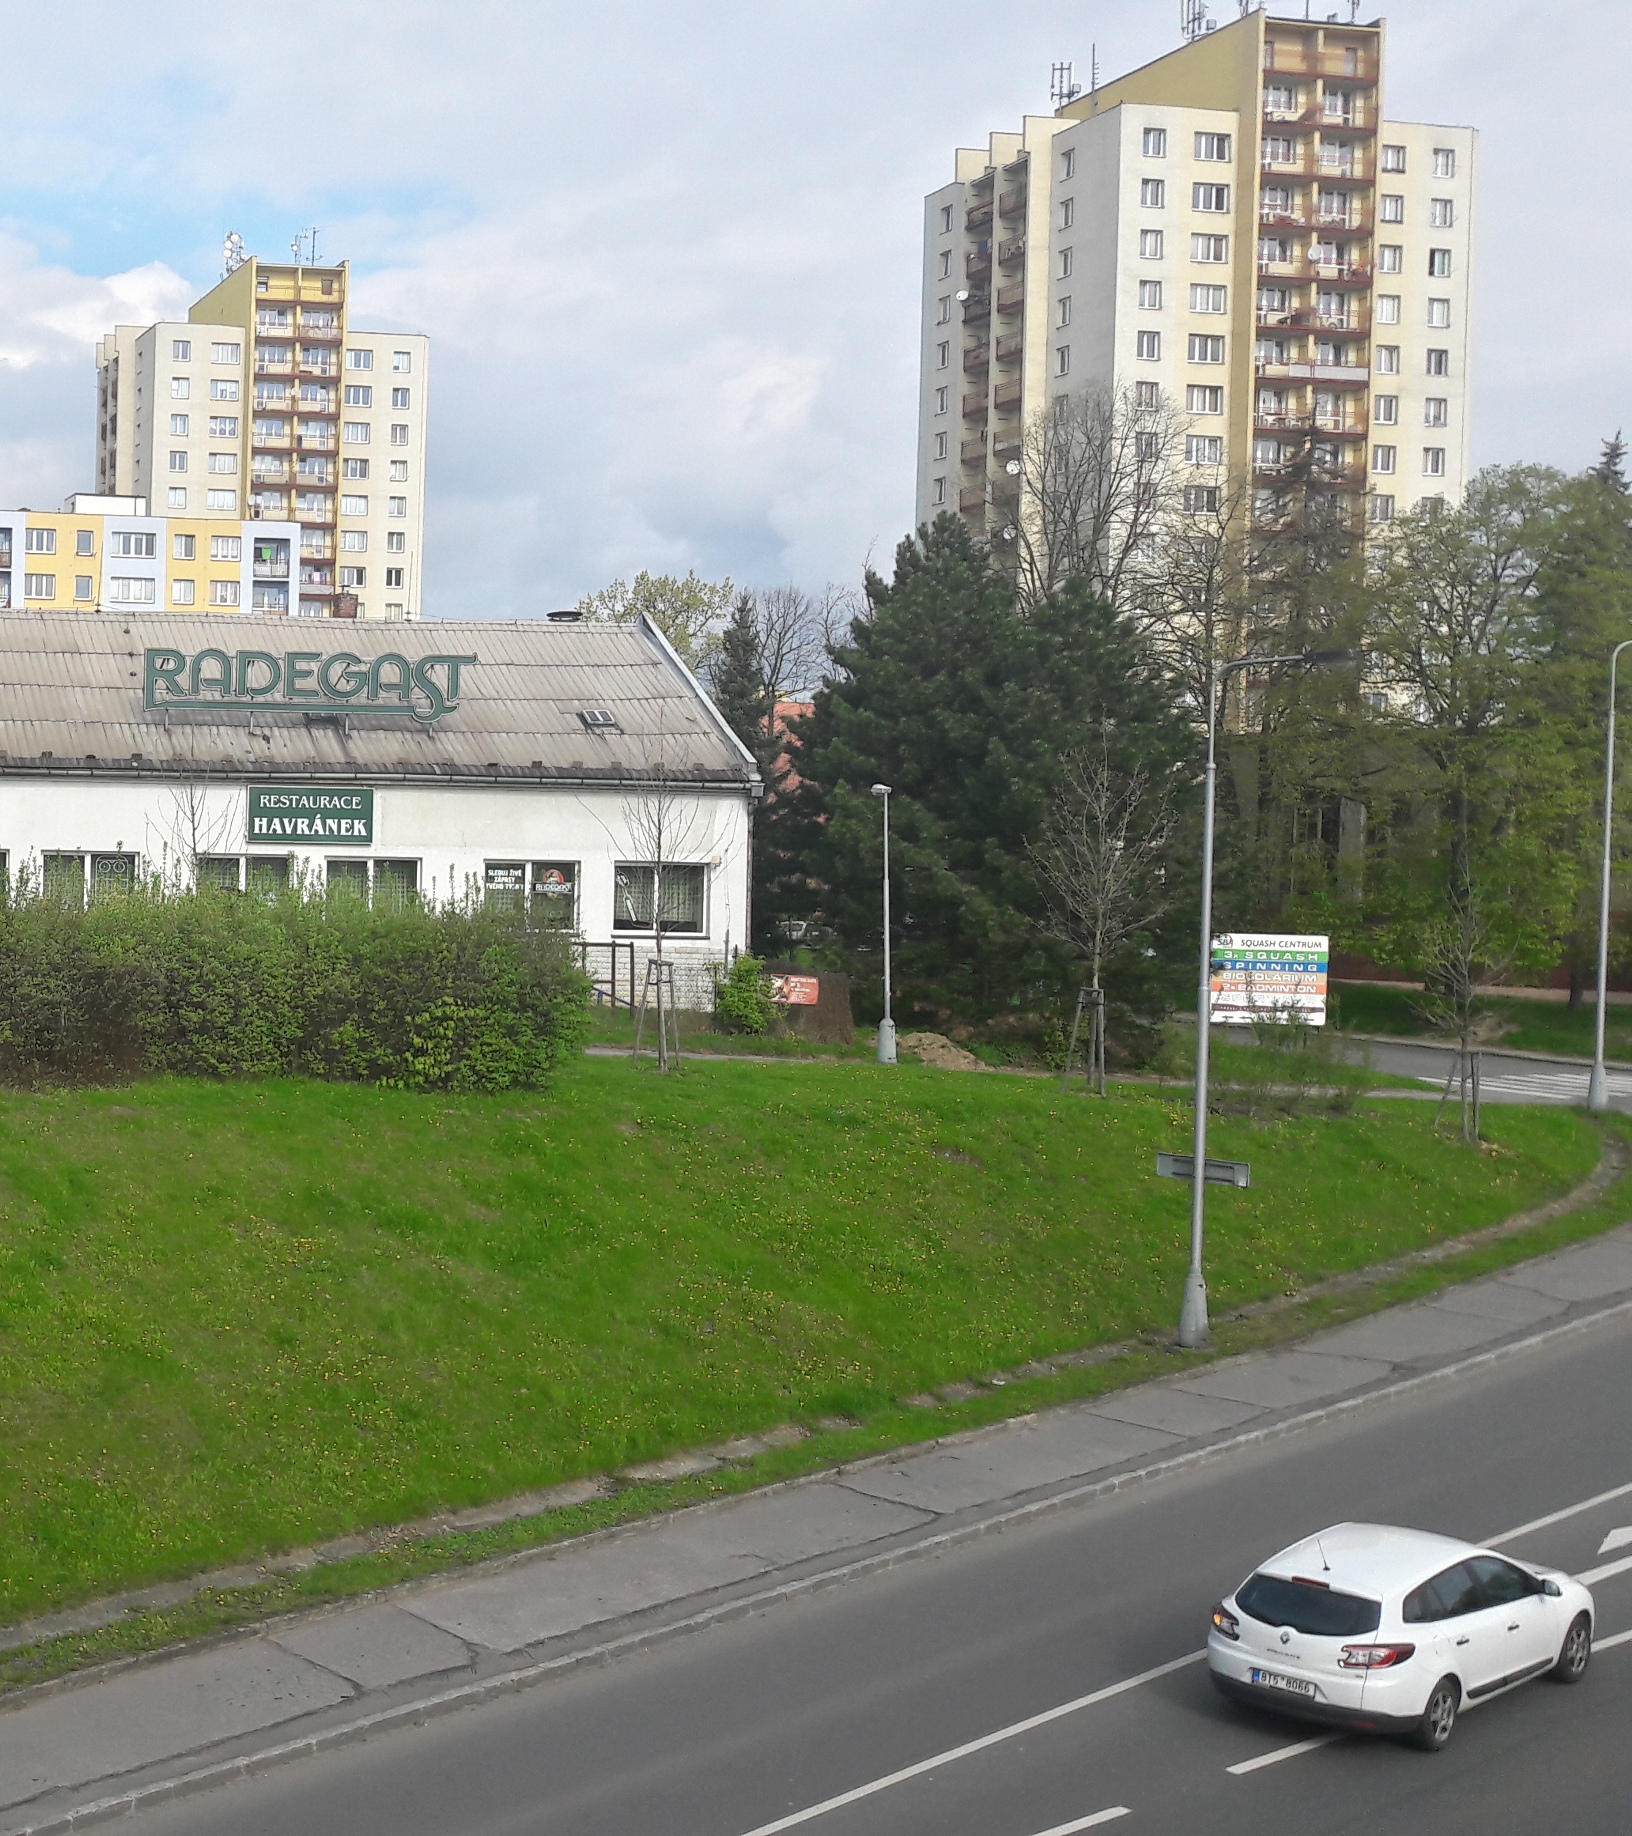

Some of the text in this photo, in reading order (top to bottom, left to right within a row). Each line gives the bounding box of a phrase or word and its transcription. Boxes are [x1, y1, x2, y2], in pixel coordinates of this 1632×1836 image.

[144, 647, 478, 723] RADEGAST
[259, 794, 362, 810] RESTAURACE
[253, 813, 368, 837] HAVRÁNEK
[1241, 939, 1276, 947] SQUASH
[1278, 940, 1322, 948] CENTRUM
[1223, 950, 1319, 961] 3x SQUASH
[1223, 961, 1318, 972] SPINNING
[1238, 983, 1317, 993] BADMINTON
